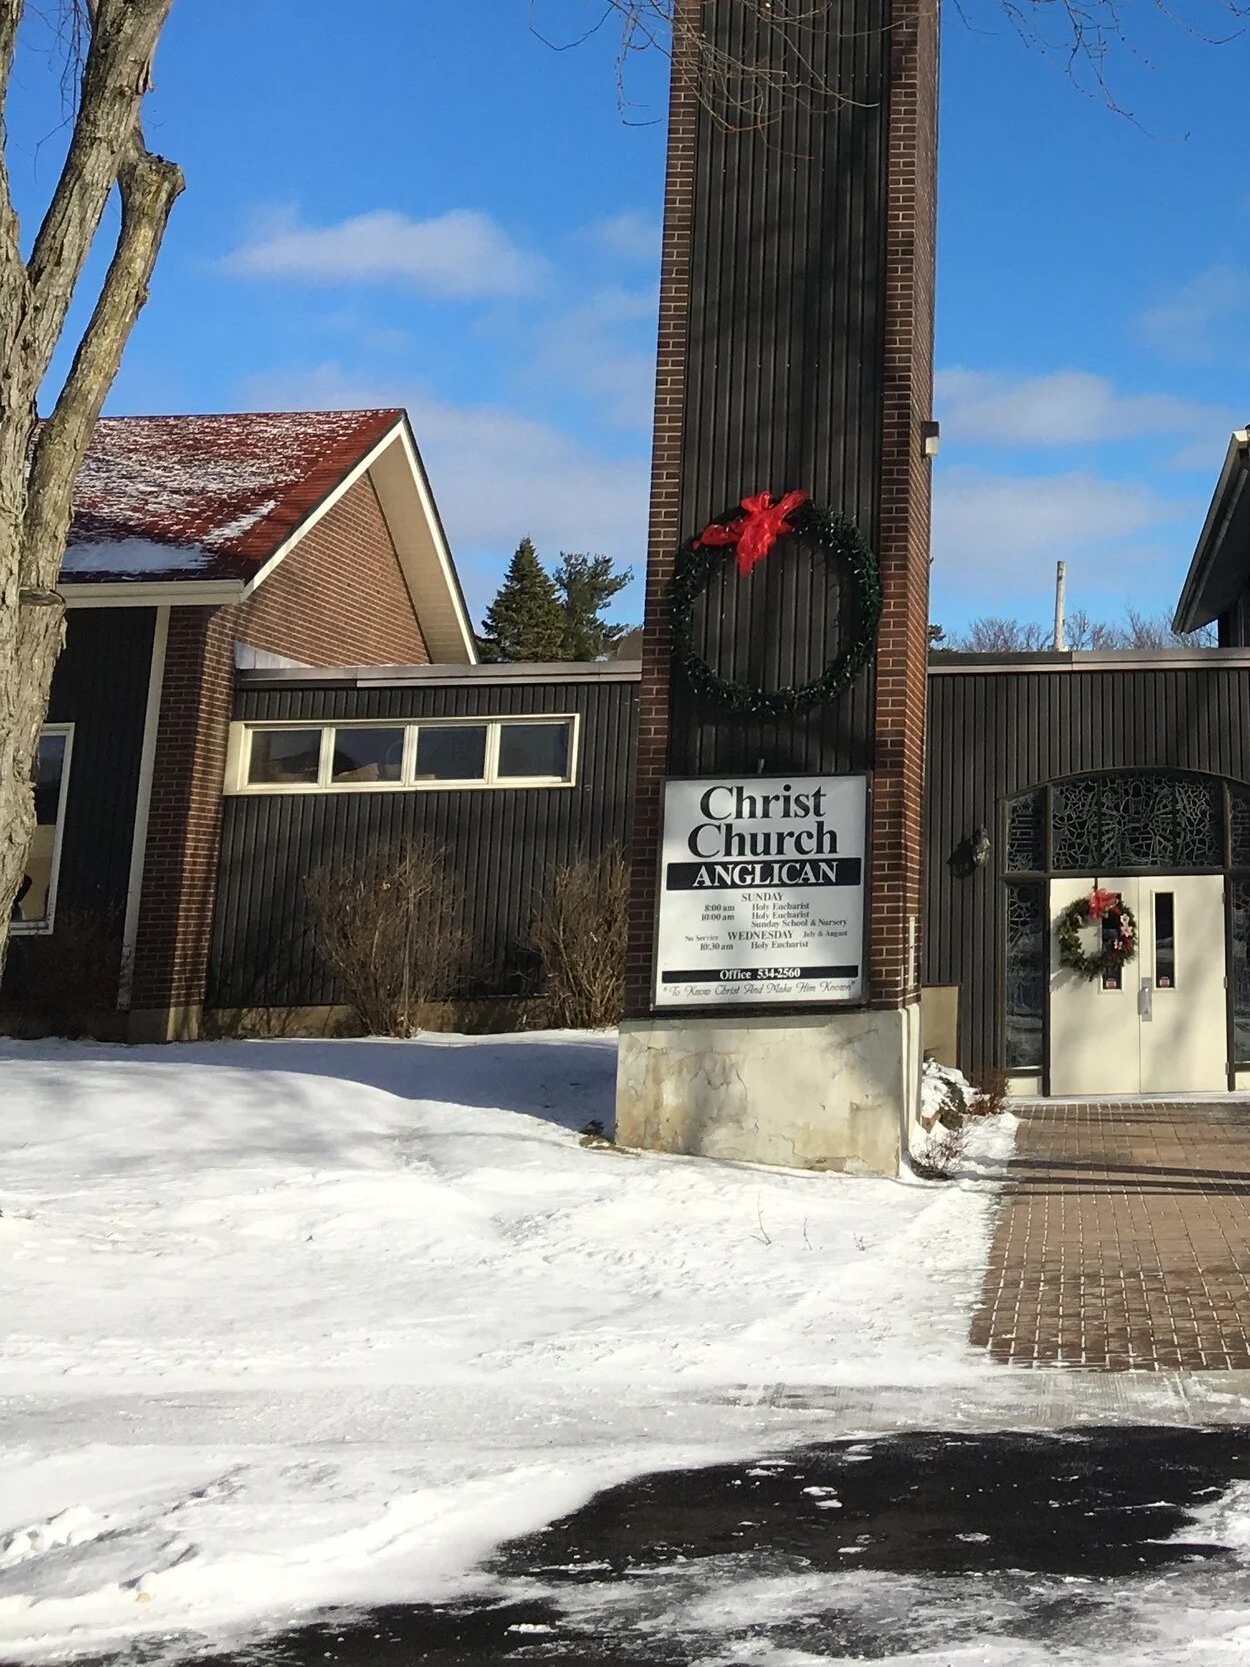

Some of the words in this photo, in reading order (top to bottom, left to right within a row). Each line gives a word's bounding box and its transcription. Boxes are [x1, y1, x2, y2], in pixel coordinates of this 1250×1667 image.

[700, 784, 827, 820] Christ
[687, 820, 839, 859] Church
[692, 861, 839, 887] ANGLICAN
[741, 892, 784, 902] SUNDAY
[704, 904, 721, 912] 8:00
[752, 903, 769, 912] Holy
[772, 902, 810, 910] Eucharist
[701, 913, 721, 921] 10:00
[752, 912, 769, 920] Holy
[772, 911, 810, 919] Eucharist
[751, 920, 779, 928] Sunday
[782, 919, 808, 927] School
[818, 919, 847, 927] Nursery
[727, 930, 793, 941] WEDNESDAY
[700, 943, 720, 951] 10:30
[751, 941, 769, 950] Holy
[771, 940, 809, 948] Eucharist
[719, 969, 752, 980] Office
[757, 967, 801, 979] 534-2560
[684, 985, 712, 997] Know
[714, 984, 741, 995] Christ
[743, 983, 765, 994] And
[766, 982, 793, 994] Make
[796, 981, 816, 993] Him
